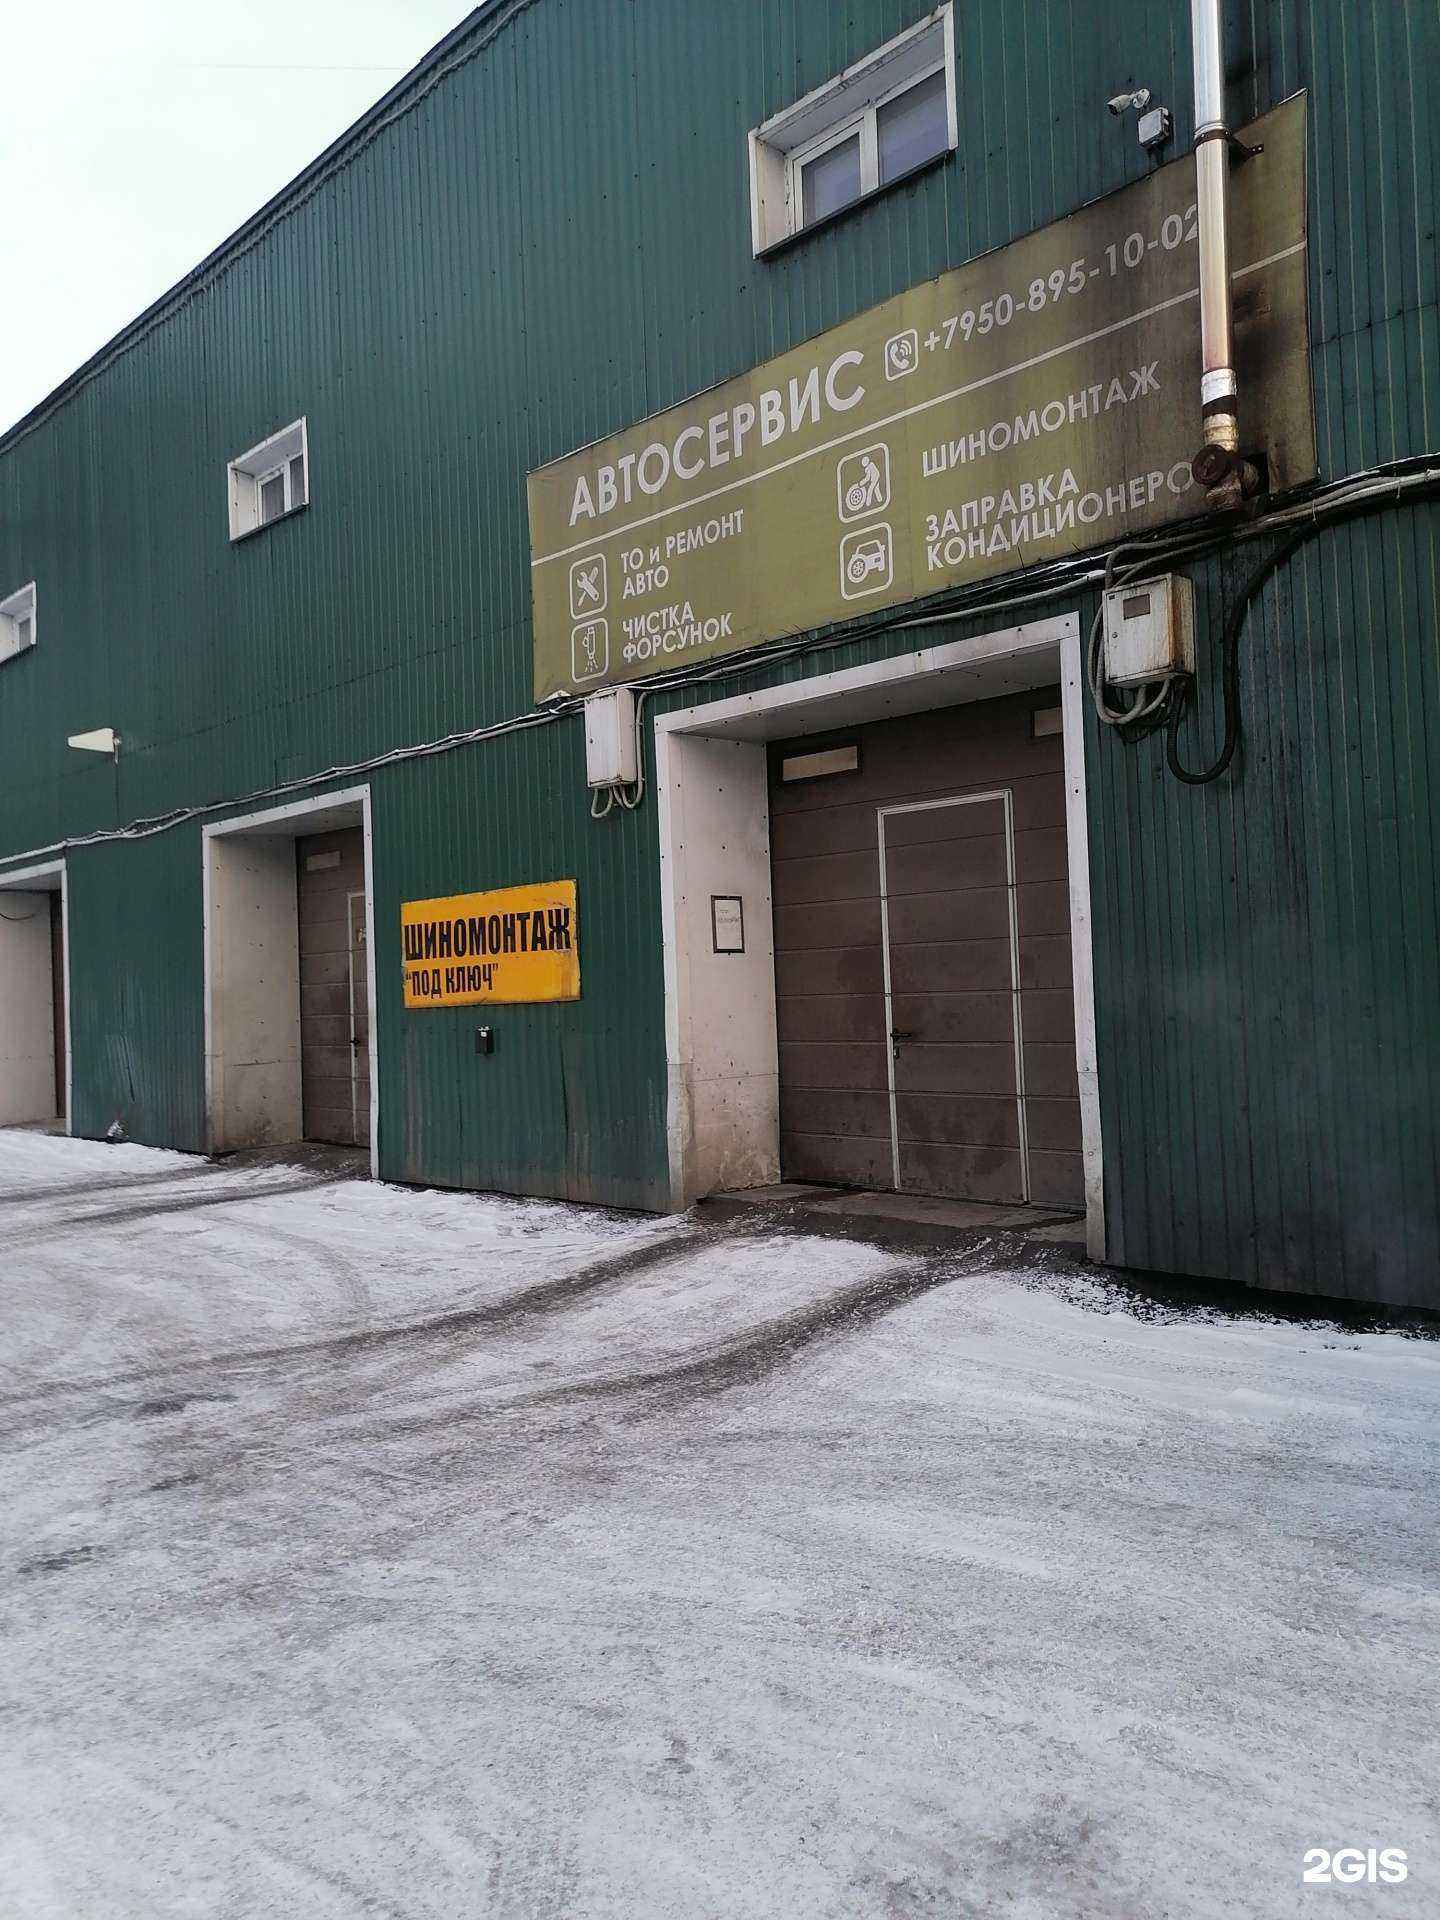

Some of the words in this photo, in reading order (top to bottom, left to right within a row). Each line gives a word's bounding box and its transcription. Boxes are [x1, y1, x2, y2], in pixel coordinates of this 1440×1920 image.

[569, 350, 865, 526] АВТОСЕРВИС
[923, 362, 1160, 477] ШИНОМОНТАЖ
[926, 468, 1079, 541] ЗАПРАВКА
[927, 461, 1196, 572] КОНДИЦИОНЕРО
[621, 551, 644, 574] ТО
[666, 509, 744, 558] РЕМОНТ
[622, 564, 669, 600] АВТО
[622, 601, 694, 640] ЧИСТКА
[622, 612, 733, 664] ФОРСУНОК
[404, 908, 571, 960] ШИНОМОНТАЖ
